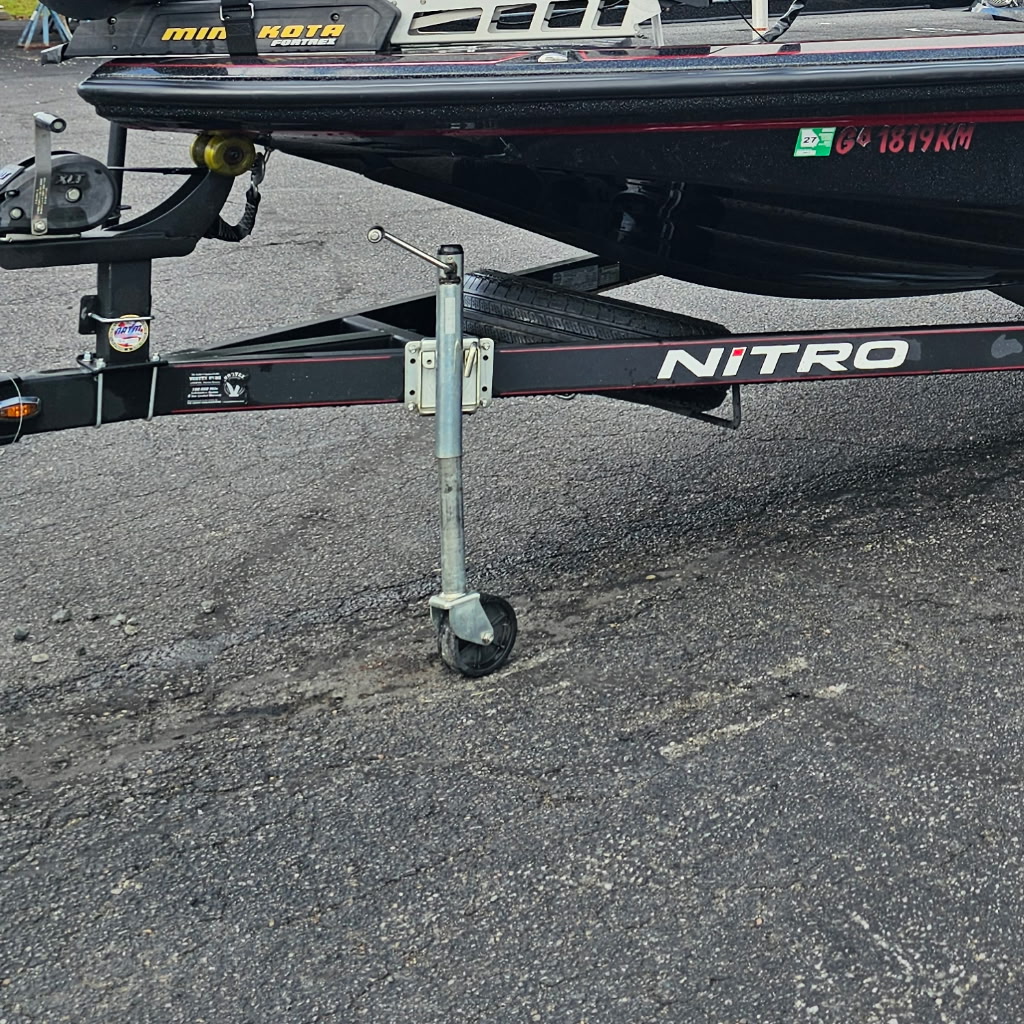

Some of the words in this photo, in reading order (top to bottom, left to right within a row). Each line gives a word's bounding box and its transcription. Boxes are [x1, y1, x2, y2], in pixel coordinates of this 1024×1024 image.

[257, 24, 345, 39] KOTA
[270, 38, 337, 47] FORTREX
[803, 136, 817, 144] 27
[657, 340, 908, 380] NITRO
